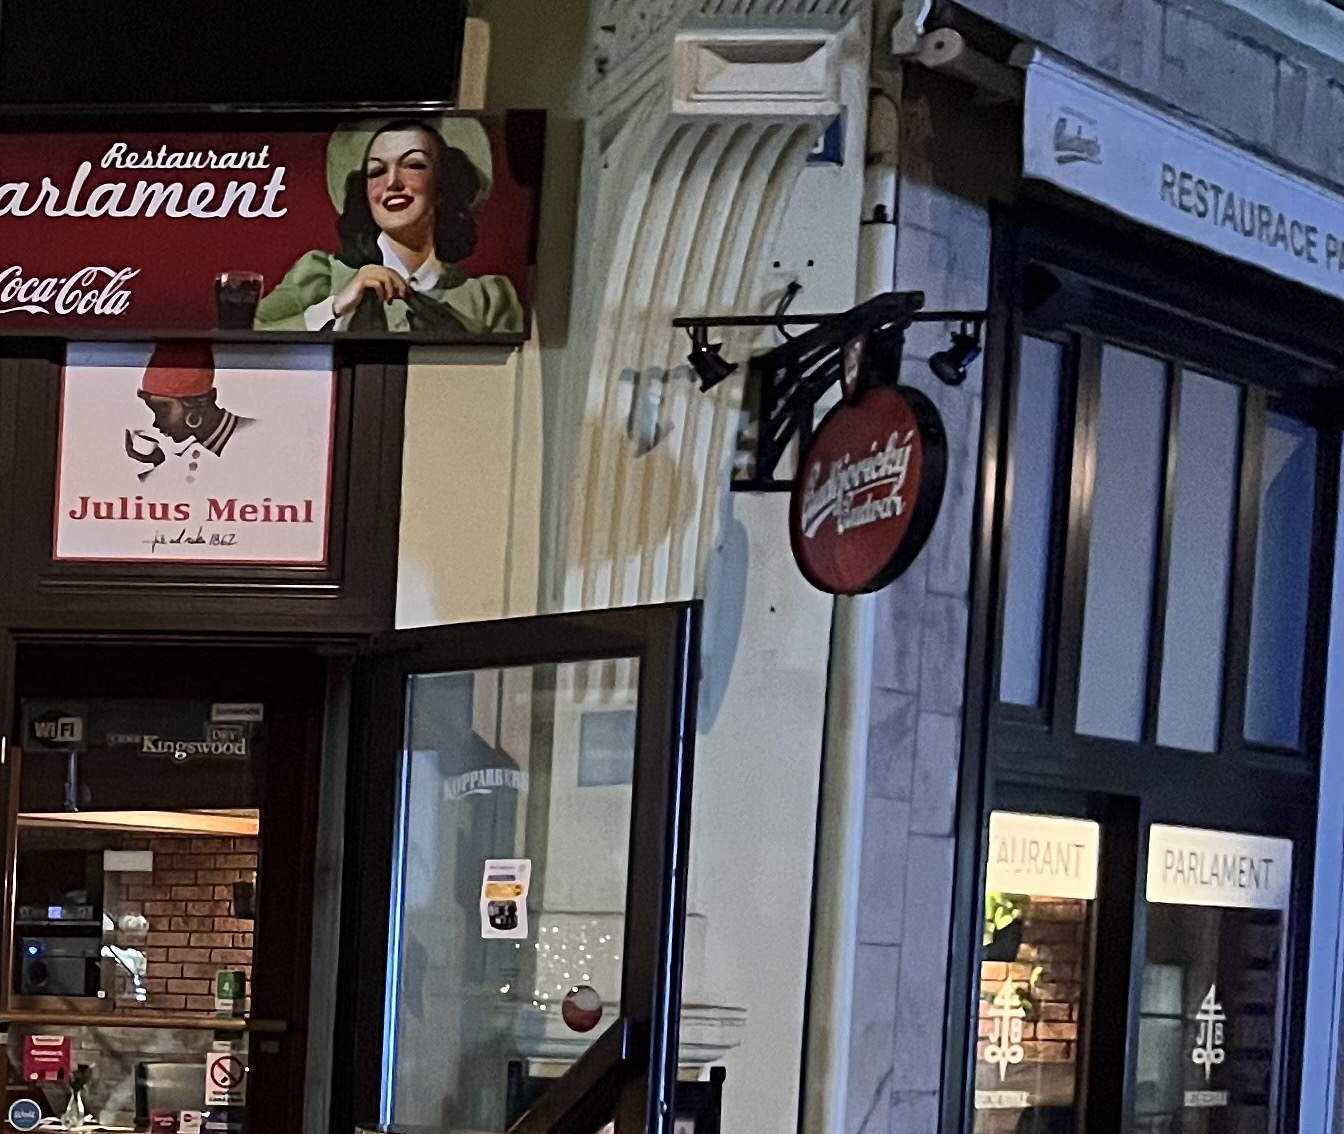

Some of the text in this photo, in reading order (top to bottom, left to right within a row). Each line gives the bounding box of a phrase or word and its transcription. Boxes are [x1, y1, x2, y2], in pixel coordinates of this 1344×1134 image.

[101, 142, 270, 171] Restaurant
[1161, 162, 1318, 264] RESTAURACE
[69, 495, 314, 525] Julius Meinl
[142, 734, 248, 761] Kingswood
[1163, 849, 1274, 889] PARLAMENT
